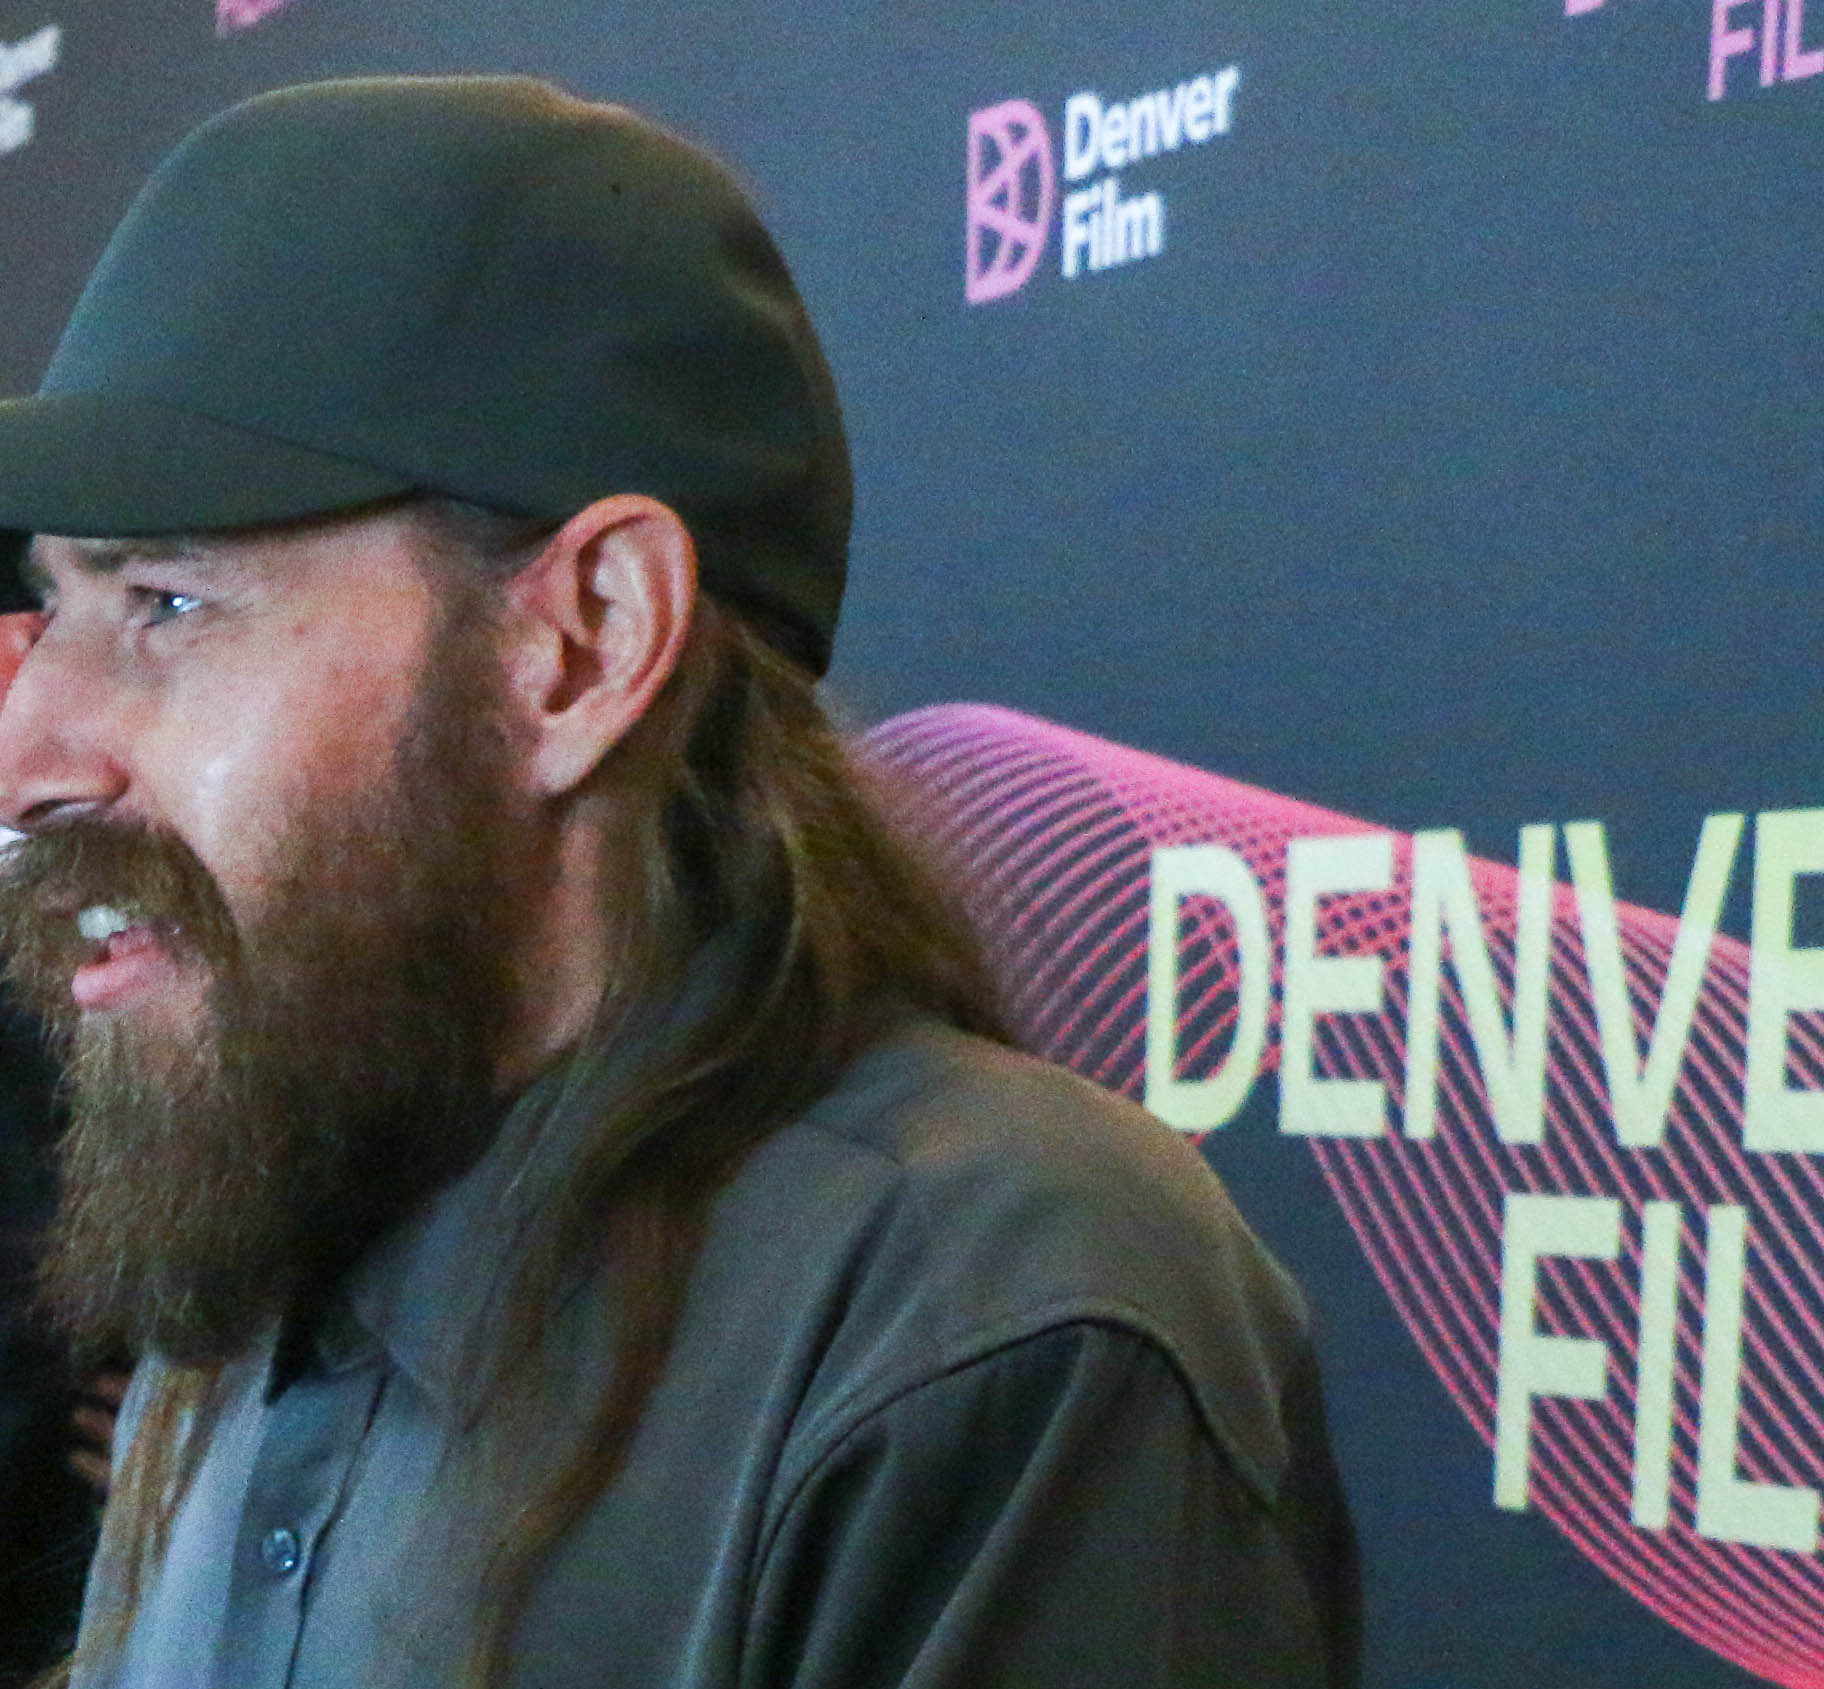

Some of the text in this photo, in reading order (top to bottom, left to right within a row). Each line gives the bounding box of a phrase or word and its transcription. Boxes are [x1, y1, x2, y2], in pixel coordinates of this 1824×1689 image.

[1063, 64, 1240, 181] Denver
[1061, 176, 1165, 278] Film
[1494, 1192, 1821, 1553] FIL
